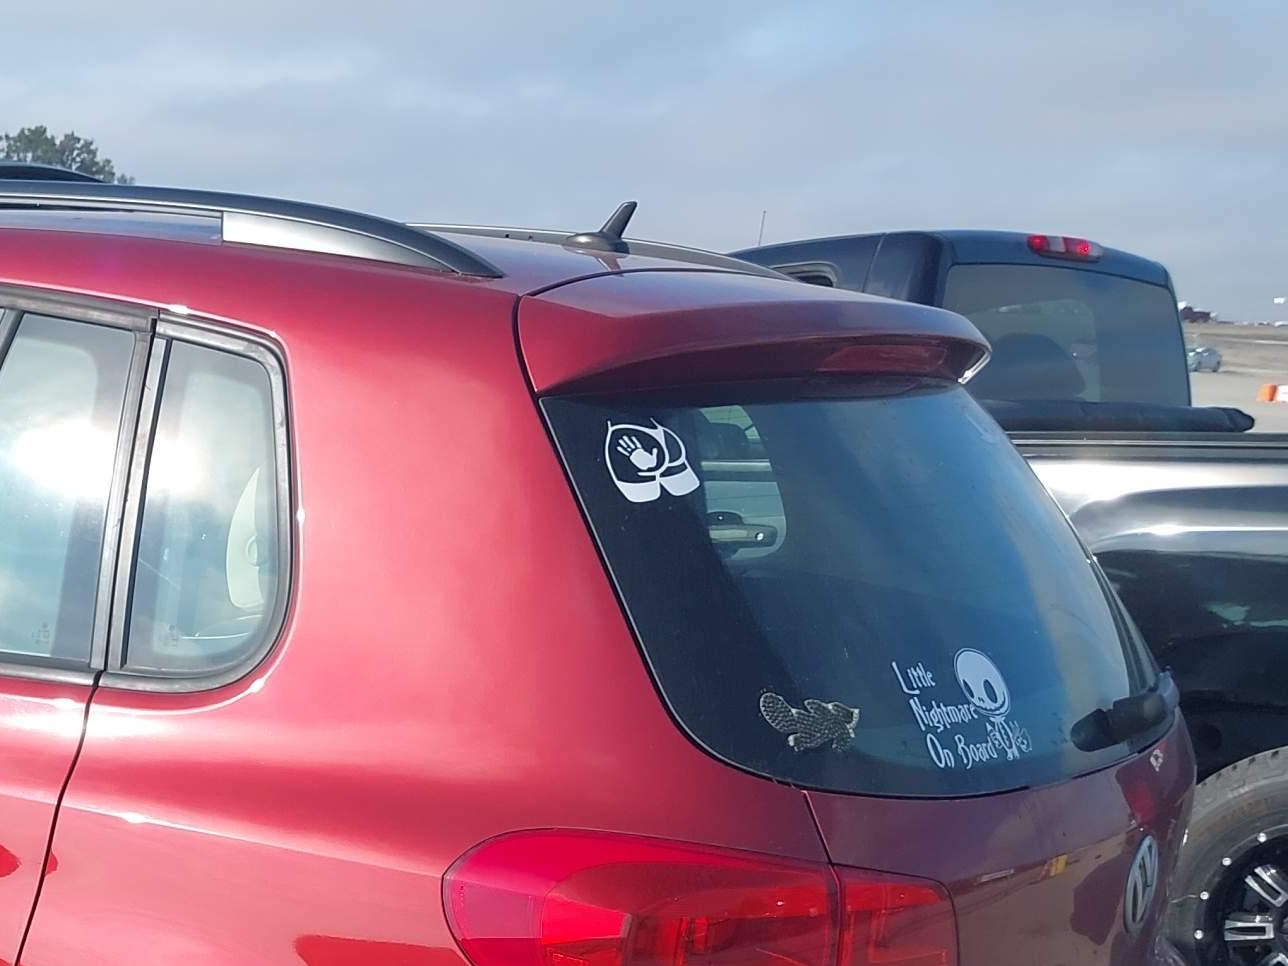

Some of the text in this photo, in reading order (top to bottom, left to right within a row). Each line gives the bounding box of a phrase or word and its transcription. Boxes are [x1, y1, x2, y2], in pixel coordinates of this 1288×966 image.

[891, 660, 937, 695] Little
[908, 696, 979, 734] Nightmare
[926, 733, 998, 770] On Board
